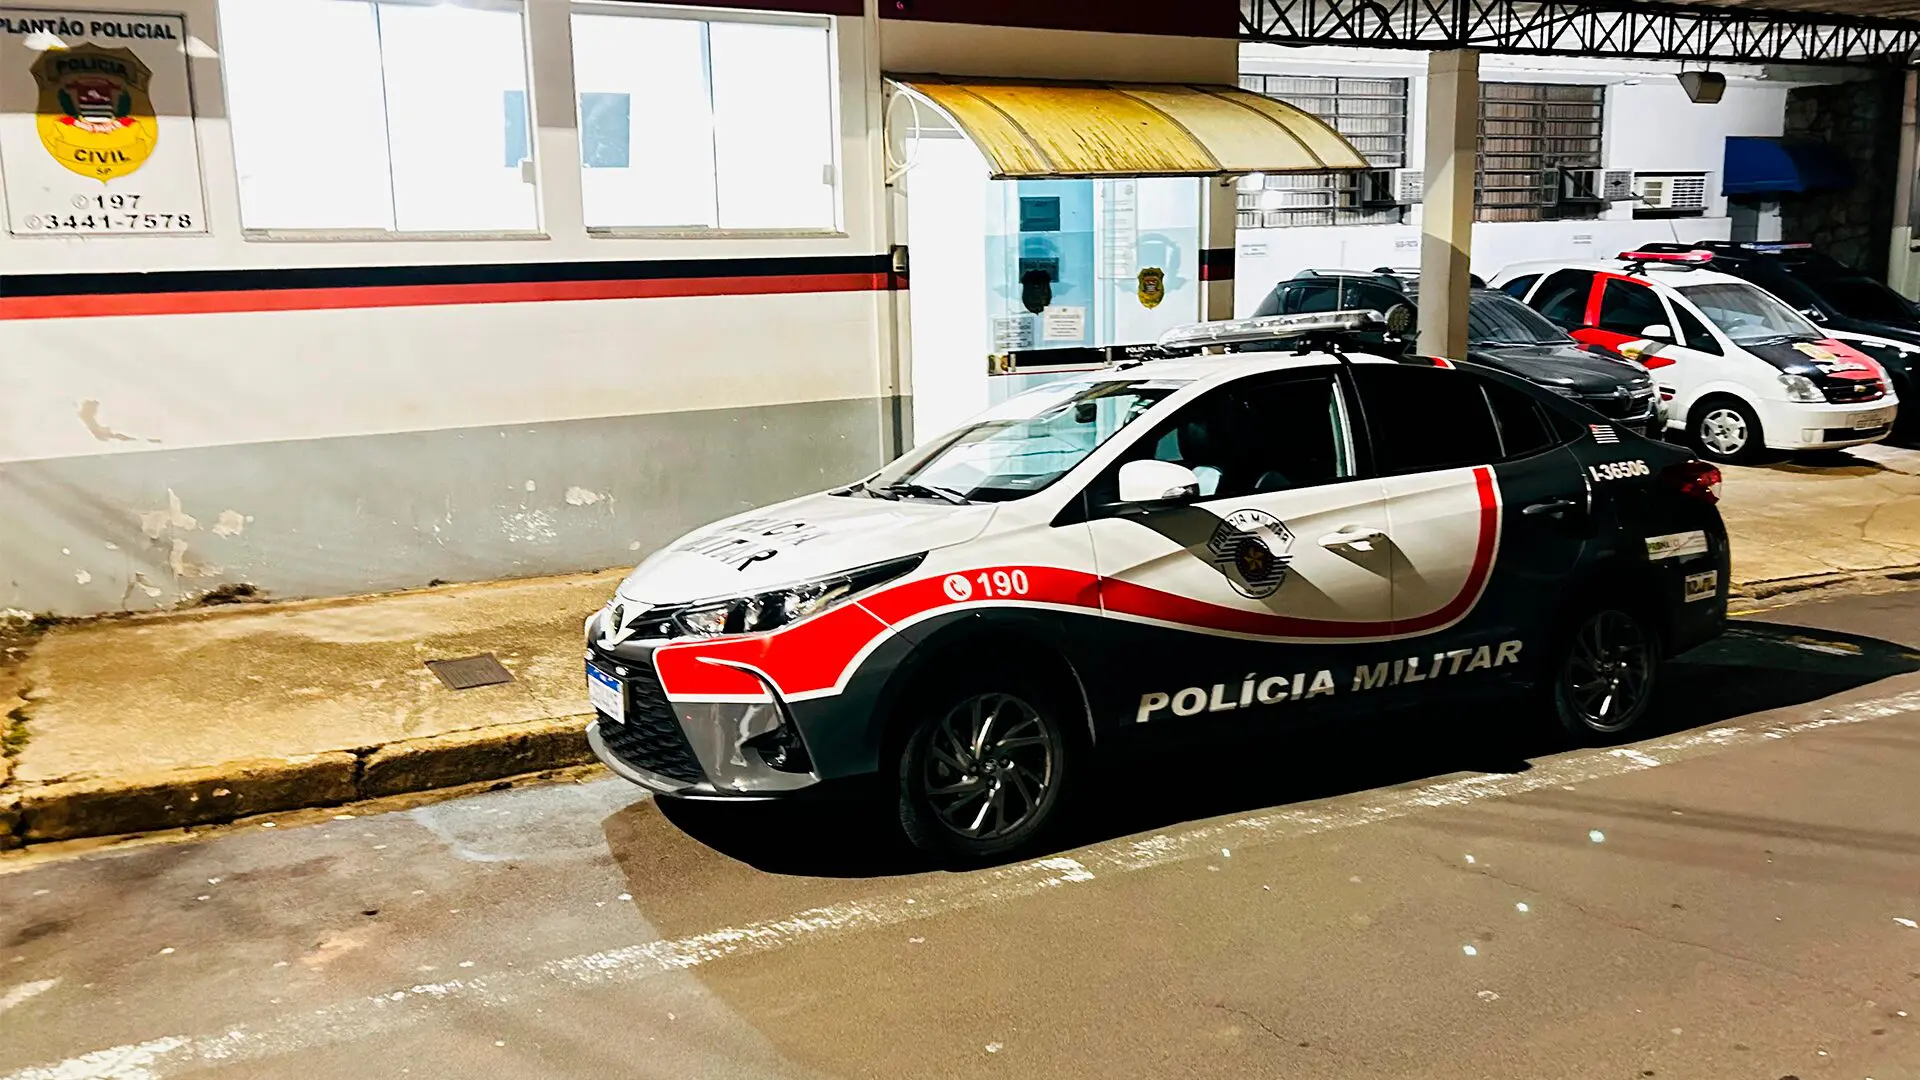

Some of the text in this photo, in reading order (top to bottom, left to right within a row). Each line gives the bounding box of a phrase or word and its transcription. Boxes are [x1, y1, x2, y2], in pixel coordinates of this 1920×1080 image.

[91, 22, 177, 40] POLICIAL
[74, 149, 131, 163] CIVIL
[92, 194, 141, 209] 197
[45, 214, 192, 229] 3441-7578
[976, 569, 1029, 597] 190
[1136, 639, 1523, 723] POLÍCIA MILITAR
